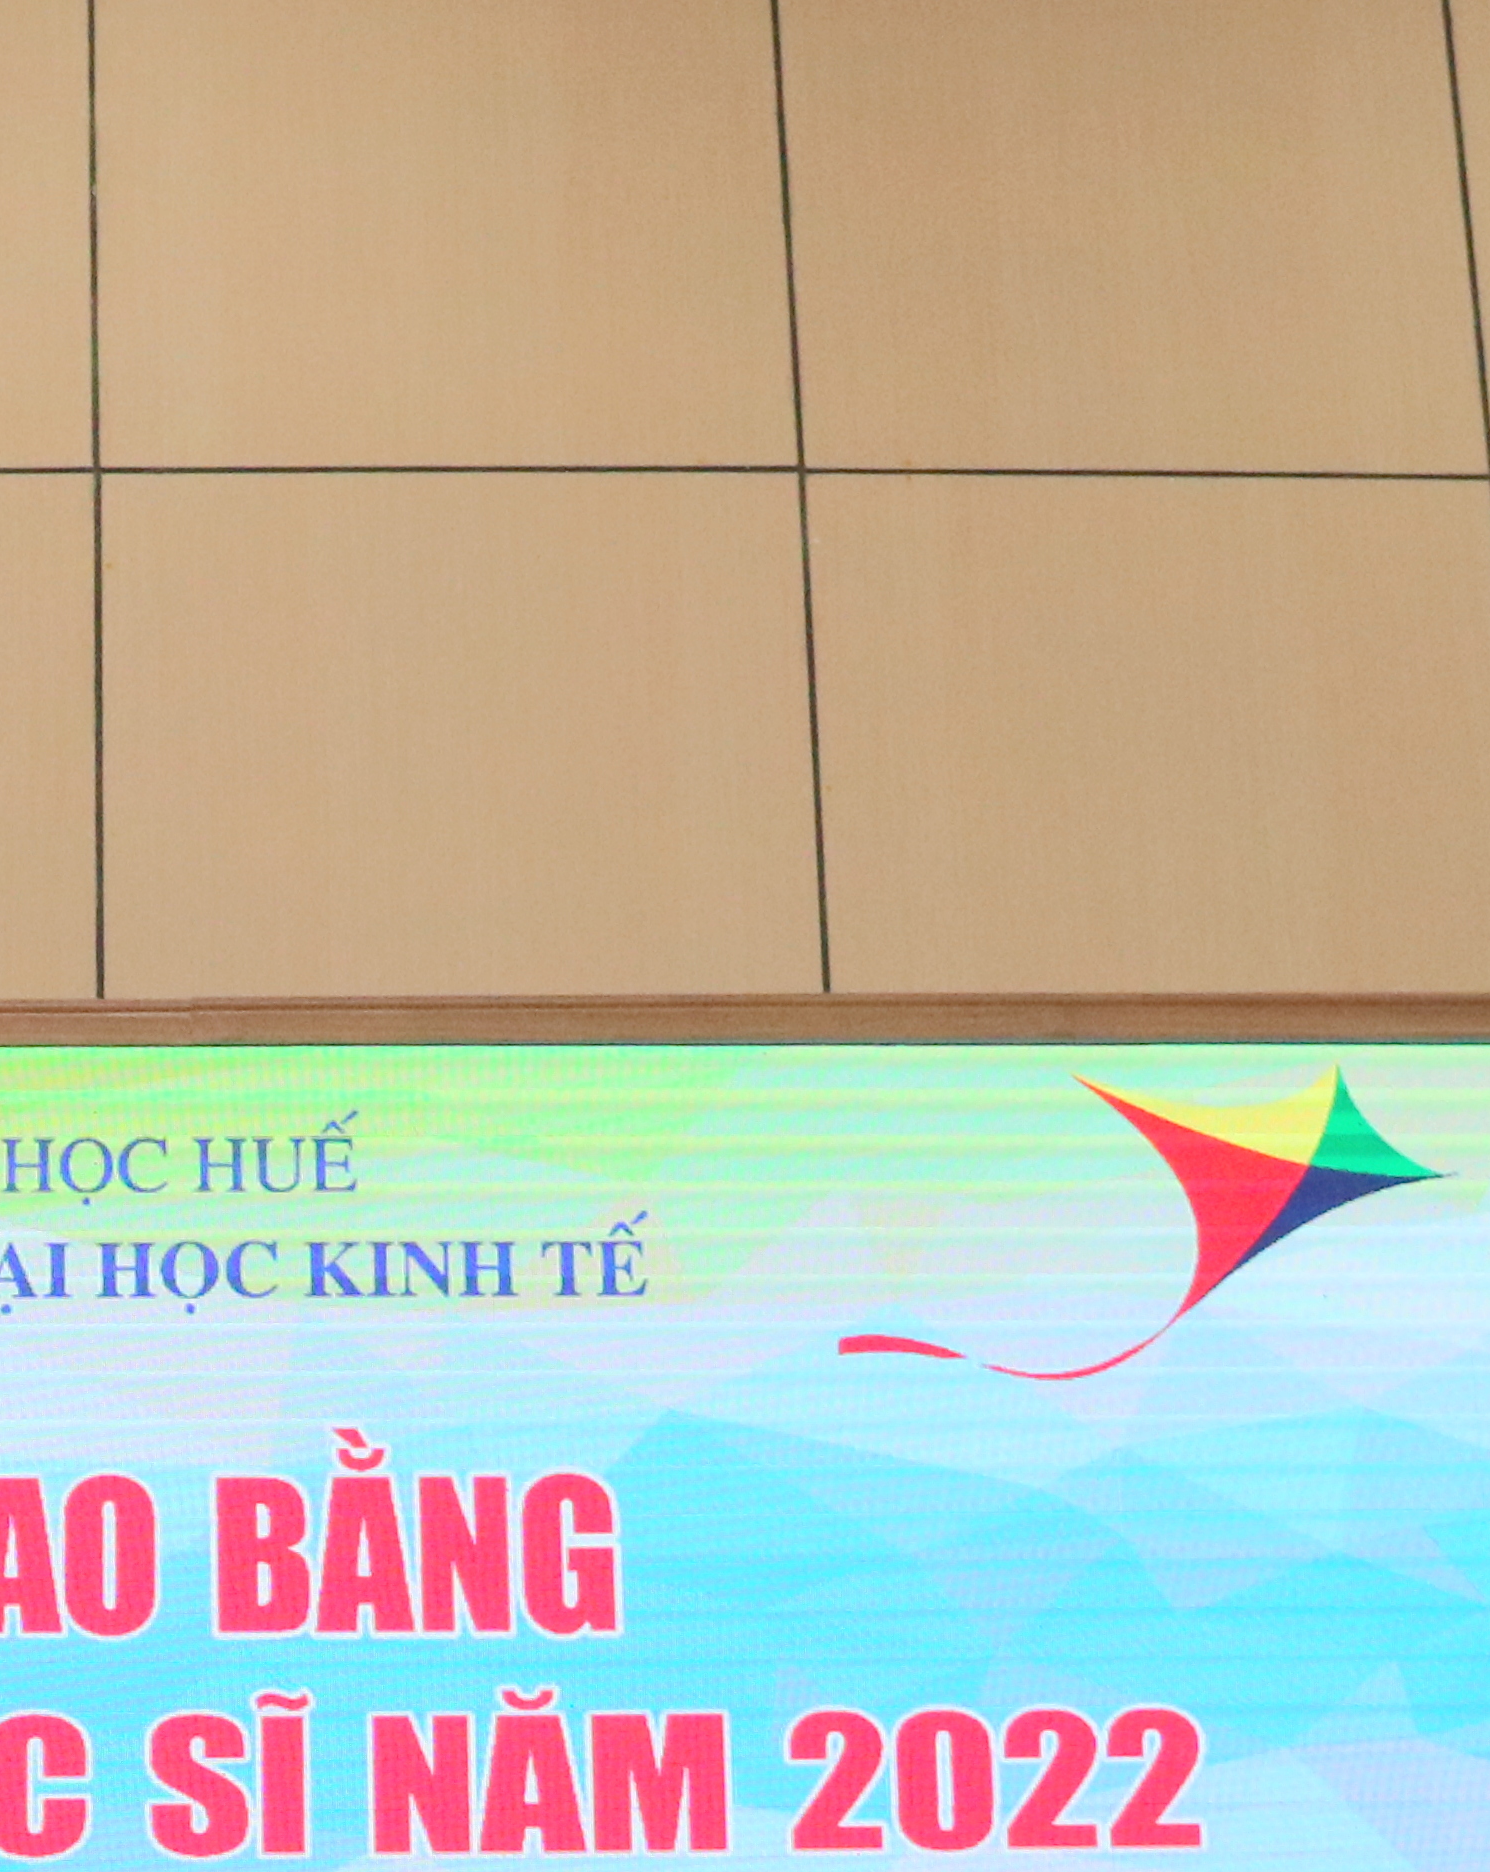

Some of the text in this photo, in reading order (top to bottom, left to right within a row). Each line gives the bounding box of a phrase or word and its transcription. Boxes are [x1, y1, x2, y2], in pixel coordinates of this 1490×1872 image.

[1, 1137, 169, 1206] HỌC
[192, 1110, 359, 1194] HUẾ
[96, 1241, 279, 1315] HỌC
[303, 1241, 519, 1298] KINH
[541, 1210, 650, 1298] TẾ
[213, 1427, 620, 1636] BẰNG
[146, 1689, 312, 1858] SĨ
[369, 1686, 728, 1855] NĂM
[785, 1706, 1204, 1853] 2022
